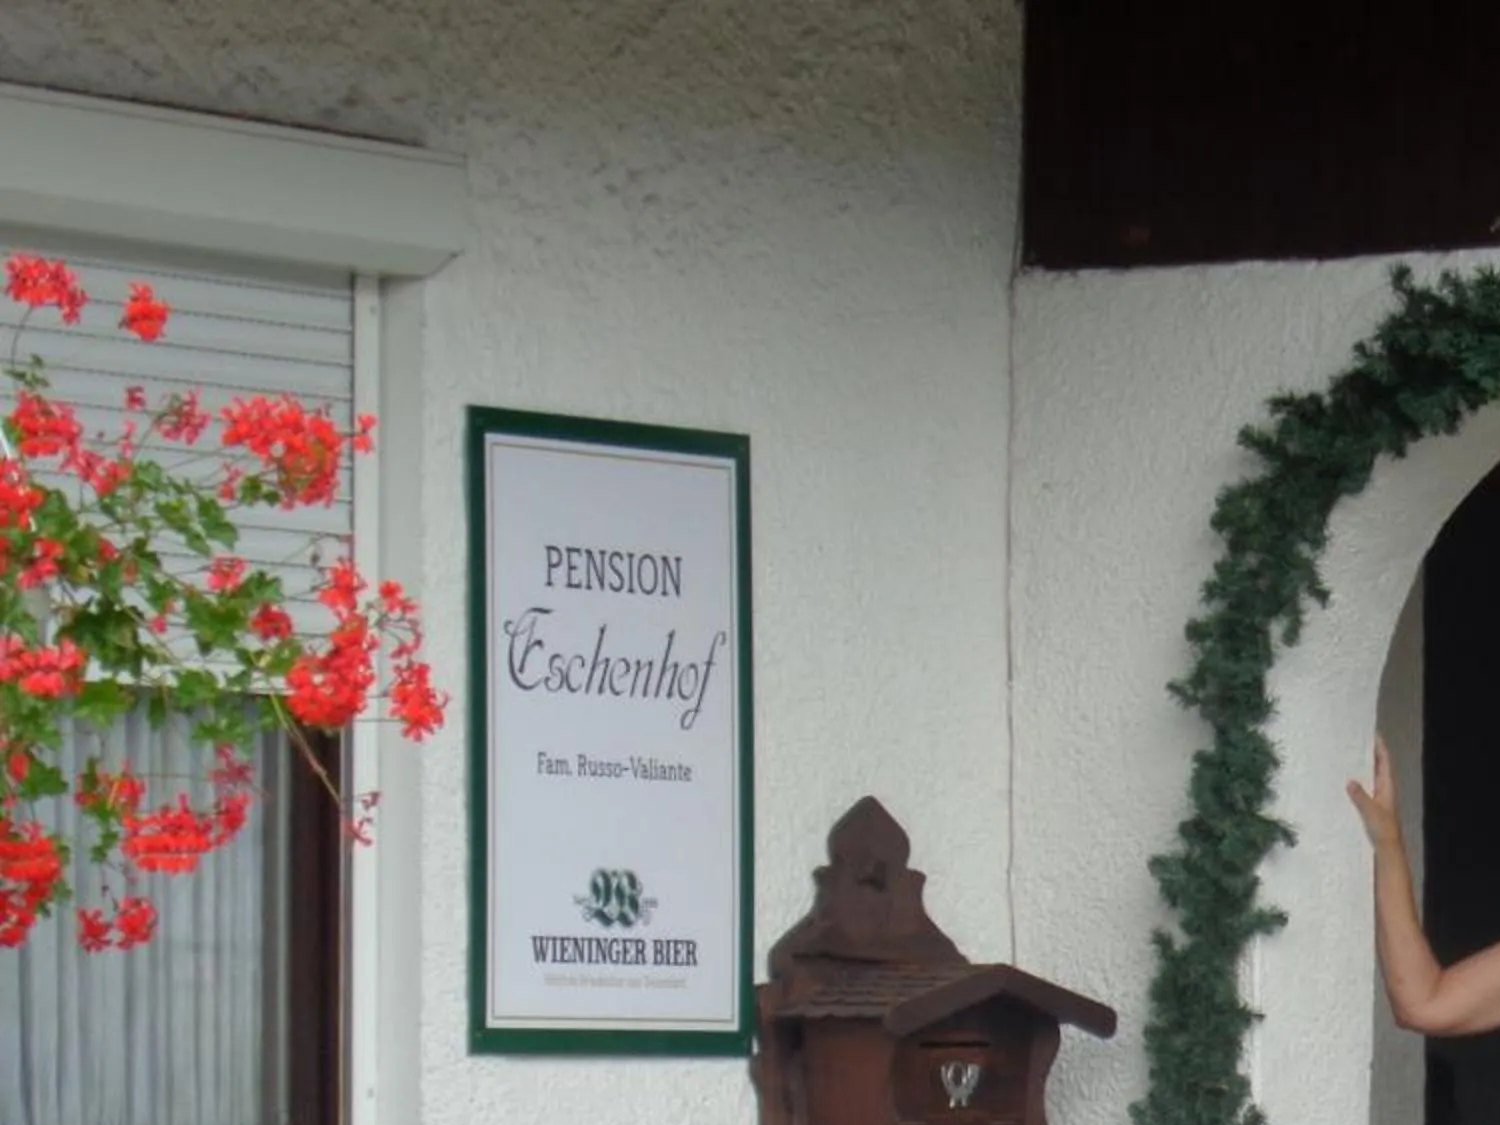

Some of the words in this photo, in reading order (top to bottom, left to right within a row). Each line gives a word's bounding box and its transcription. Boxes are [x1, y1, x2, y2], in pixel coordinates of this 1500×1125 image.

[544, 544, 683, 599] PENSION
[503, 606, 727, 731] Eschenhof
[536, 751, 573, 776] Fam.
[577, 753, 693, 782] Russo-Valiante
[531, 935, 648, 966] WIENINGER
[652, 938, 698, 967] BIER
